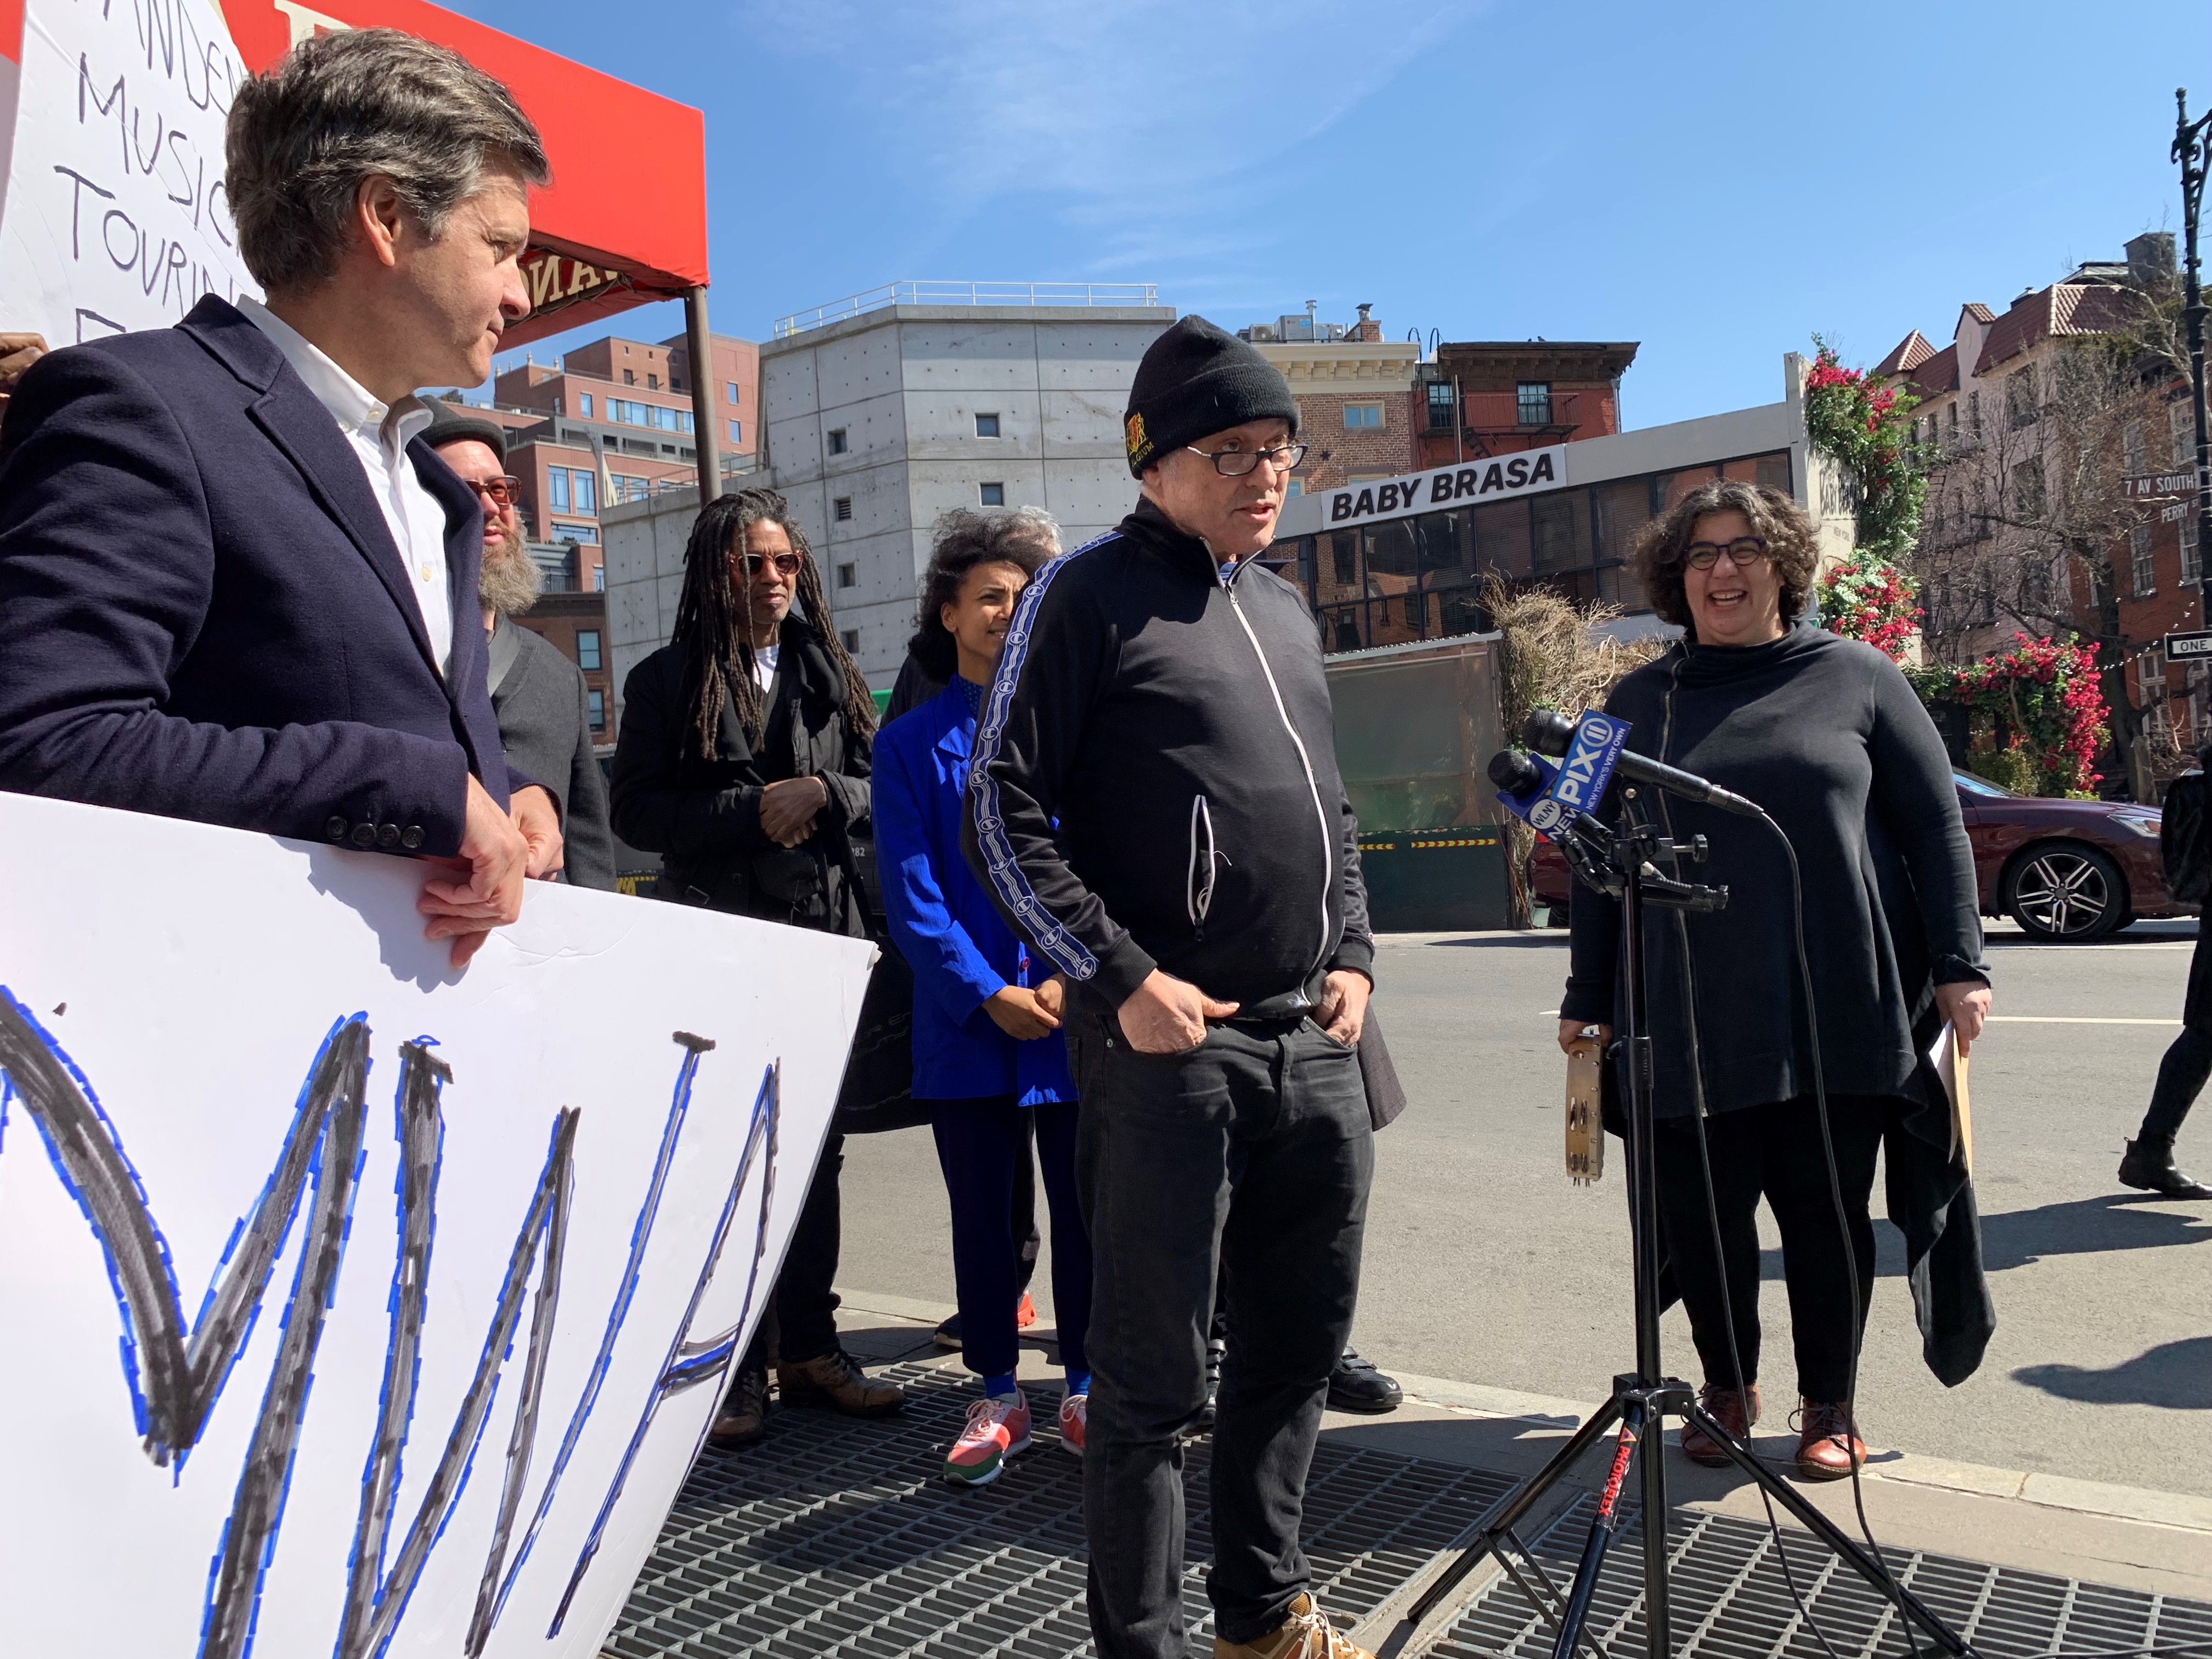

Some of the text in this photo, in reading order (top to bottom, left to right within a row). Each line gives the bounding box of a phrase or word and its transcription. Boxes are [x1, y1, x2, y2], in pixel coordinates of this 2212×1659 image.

[1331, 453, 1555, 522] BABY BRASA
[2125, 475, 2194, 495] 7 AV SOUTH
[2162, 501, 2188, 523] PERRY
[2180, 640, 2208, 652] ONE
[1556, 742, 1603, 805] PIX
[1585, 727, 1626, 810] NEW YORK'S VERY OWN
[1533, 800, 1556, 826] WLNY
[1598, 1446, 1631, 1517] PHOTOFLEX
